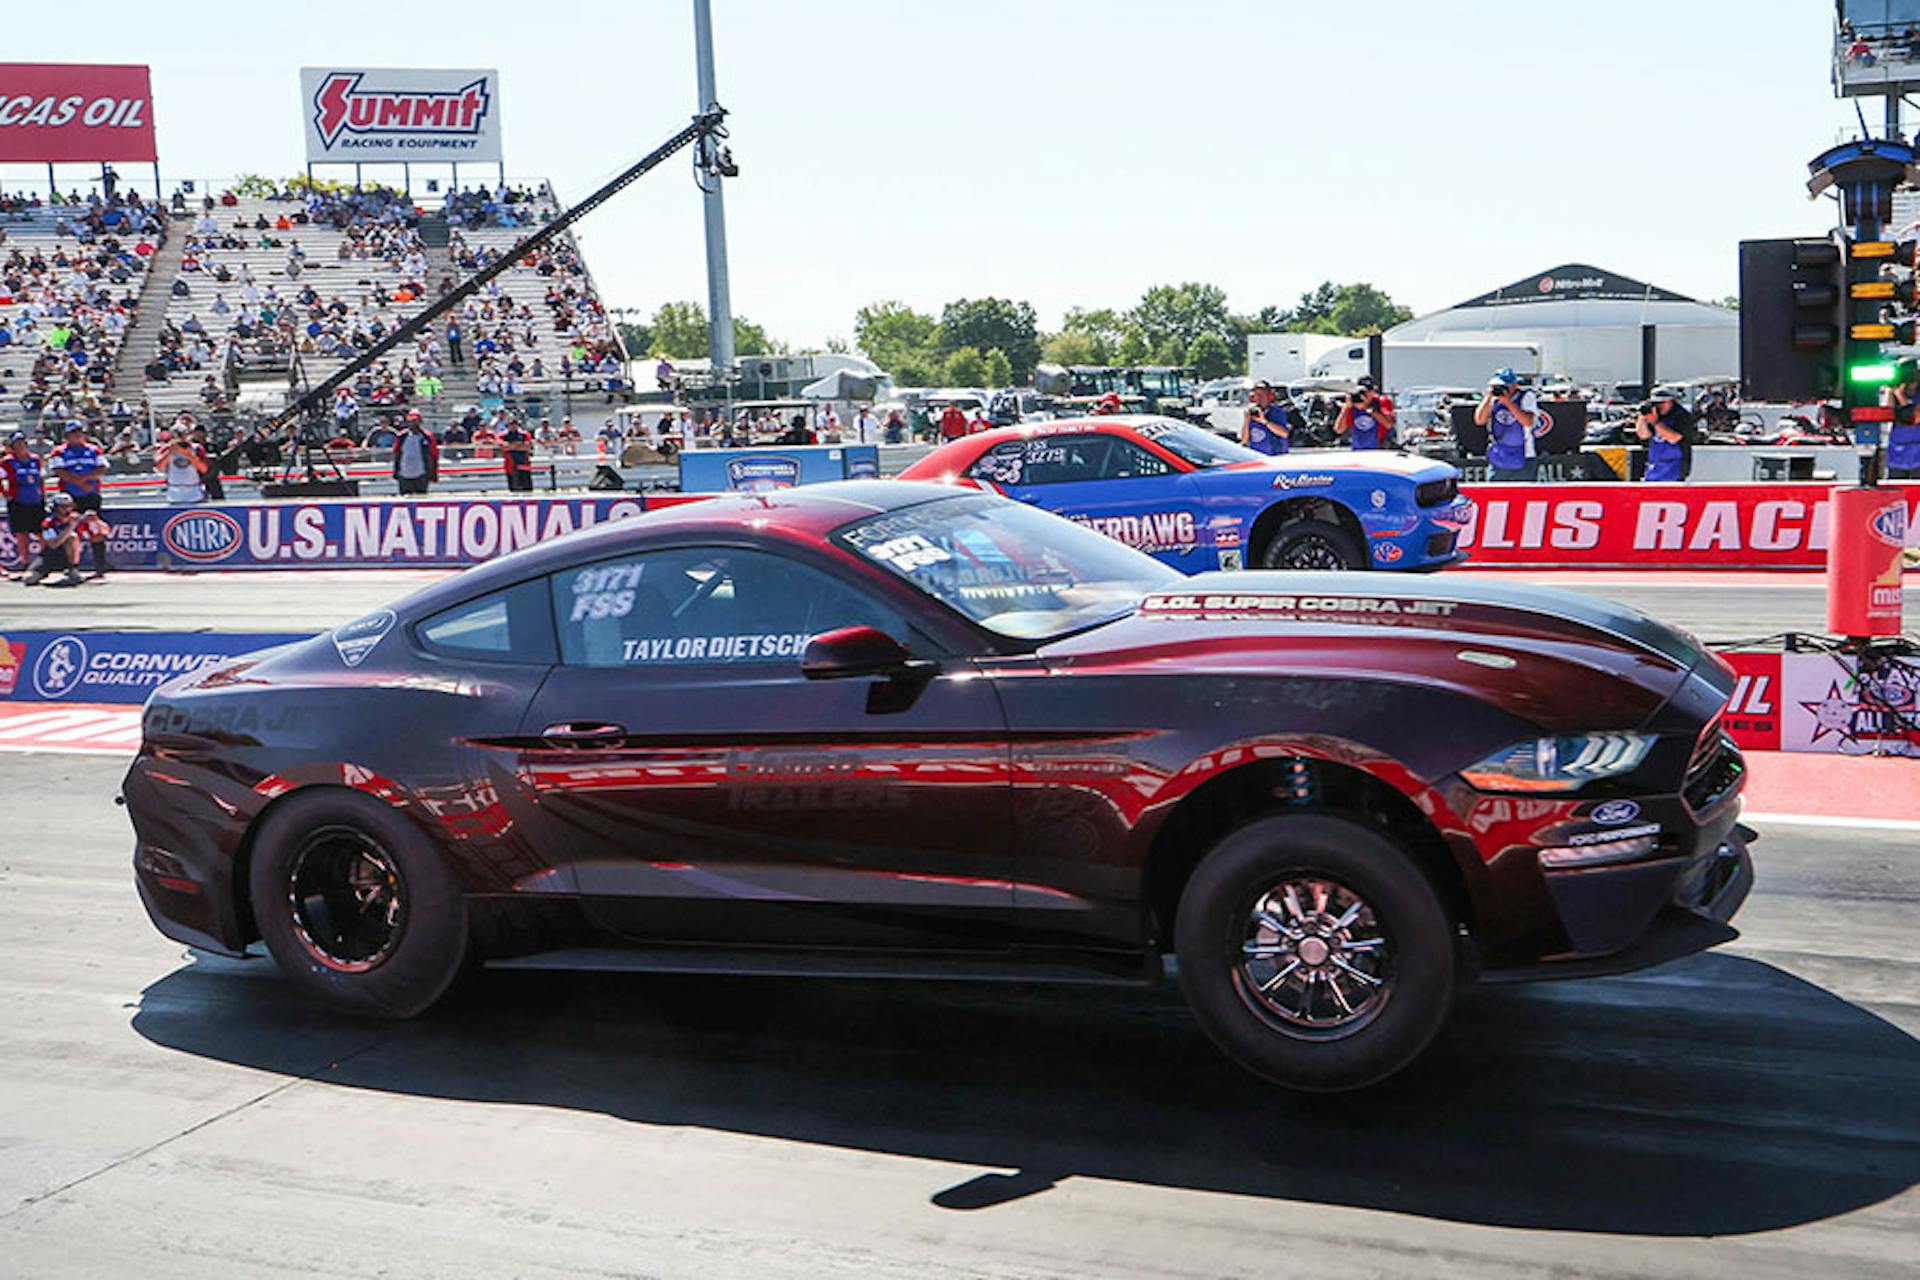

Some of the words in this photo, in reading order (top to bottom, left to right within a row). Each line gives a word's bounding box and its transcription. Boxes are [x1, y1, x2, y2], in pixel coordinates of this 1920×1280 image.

[83, 97, 144, 126] OIL
[341, 138, 393, 149] RACING
[399, 138, 478, 149] EQUIPMENT
[174, 518, 232, 550] NHRA
[247, 506, 337, 560] U.S.
[105, 541, 158, 552] TOOLS
[1204, 597, 1296, 609] SUPER
[1299, 597, 1400, 613] COBRA
[1402, 600, 1458, 616] JET
[623, 636, 706, 661] TAYLOR
[82, 671, 171, 685] QUALITY
